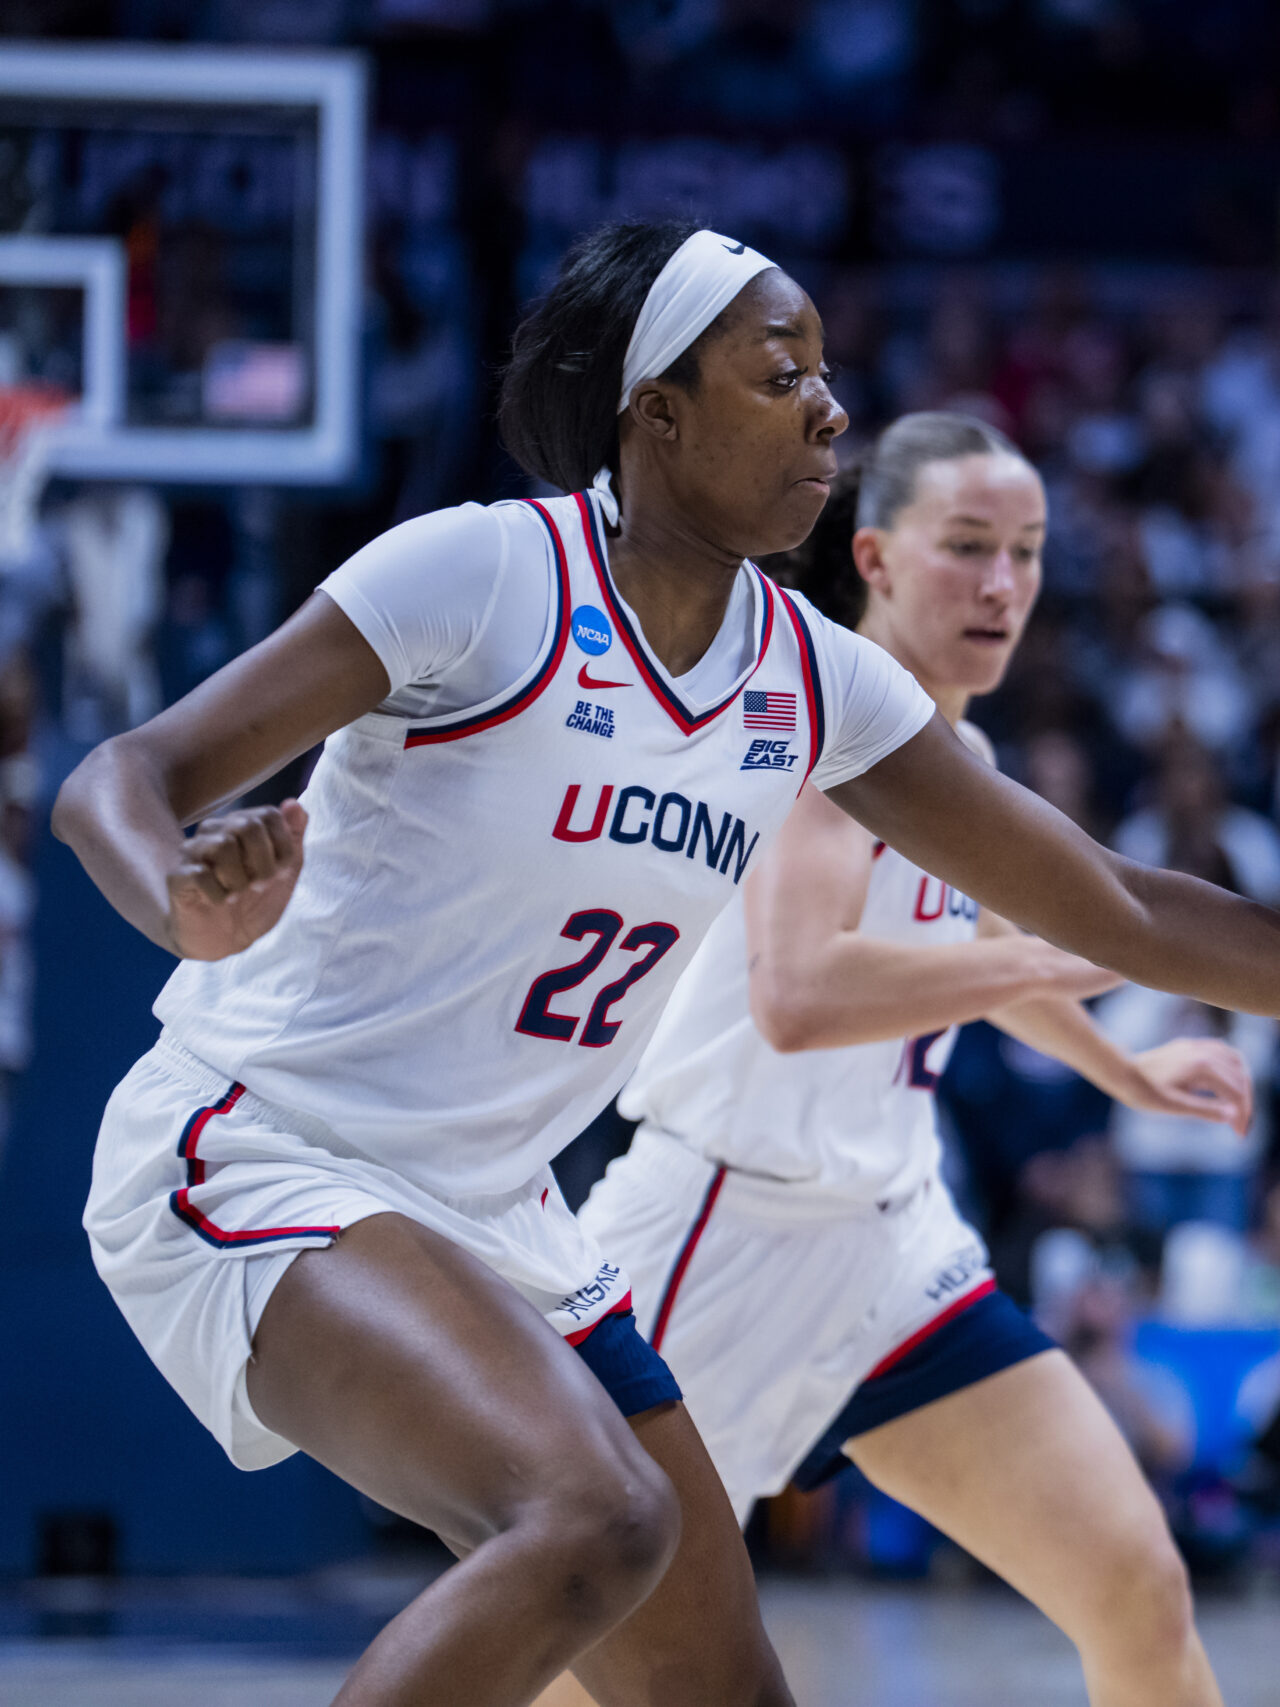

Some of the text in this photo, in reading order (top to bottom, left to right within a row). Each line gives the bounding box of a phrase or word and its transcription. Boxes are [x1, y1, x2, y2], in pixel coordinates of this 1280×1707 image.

[577, 624, 610, 647] NCAA
[575, 700, 615, 723] BE THE
[565, 715, 616, 739] CHANGE
[749, 738, 790, 753] BIG
[742, 752, 798, 768] EAST
[551, 784, 760, 885] UCONN
[514, 908, 681, 1049] 22
[555, 1259, 621, 1321] HUSKIE
